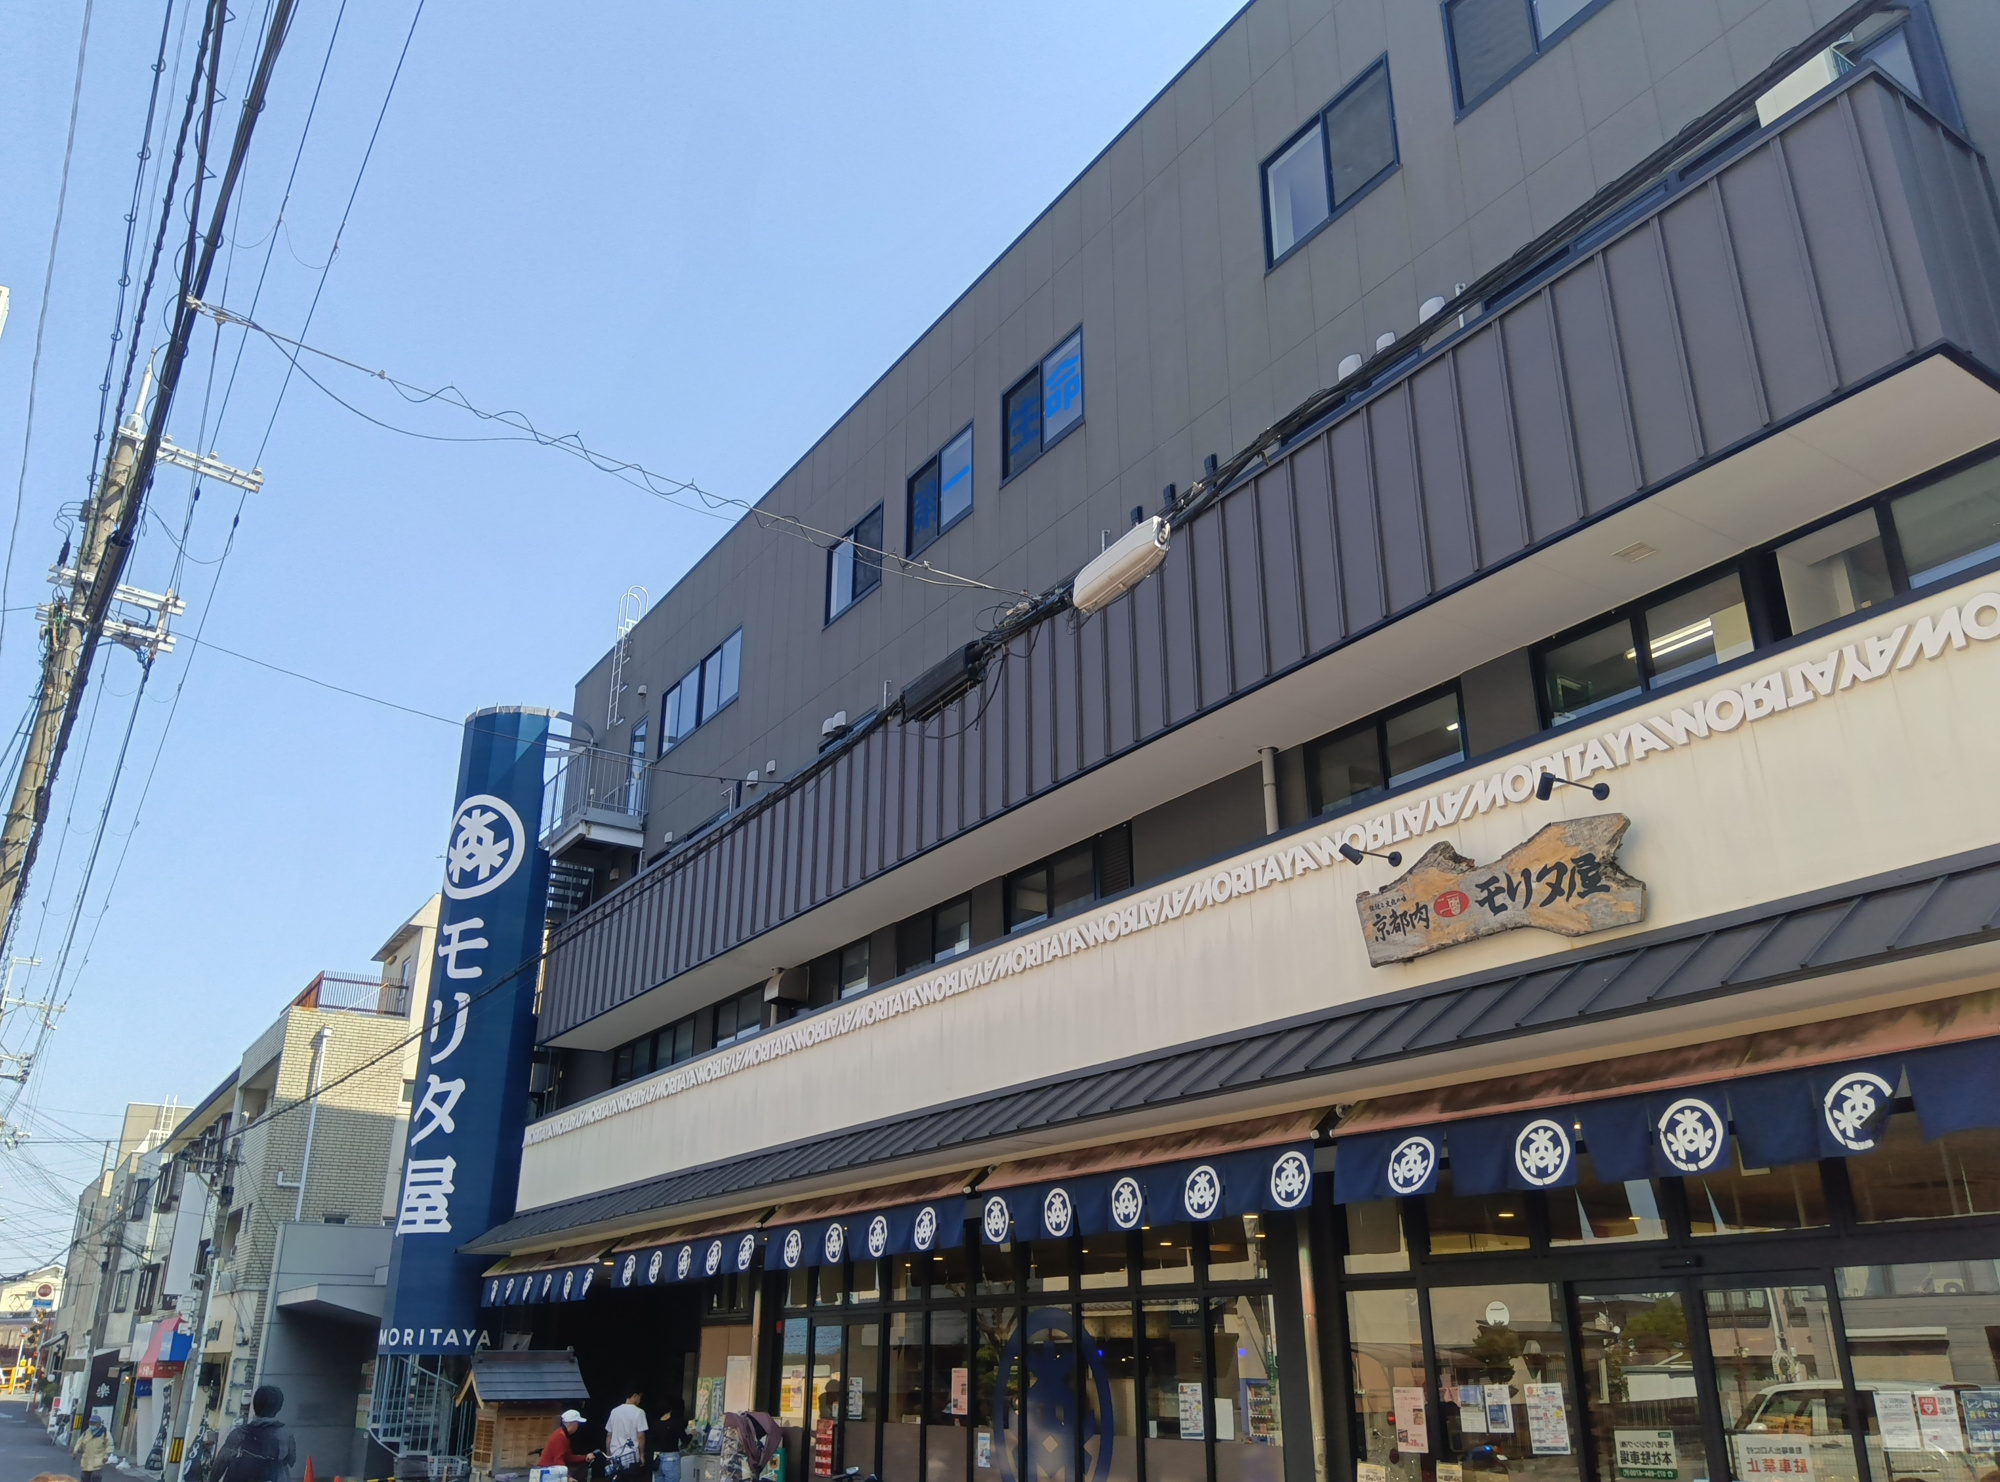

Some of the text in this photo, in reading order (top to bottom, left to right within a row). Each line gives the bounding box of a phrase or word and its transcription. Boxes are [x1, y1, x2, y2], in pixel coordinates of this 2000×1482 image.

[1475, 852, 1611, 917] モリタ屋
[1372, 902, 1430, 943] 京都肉
[395, 917, 489, 1238] モリタ屋
[378, 1327, 491, 1346] MORITAYA
